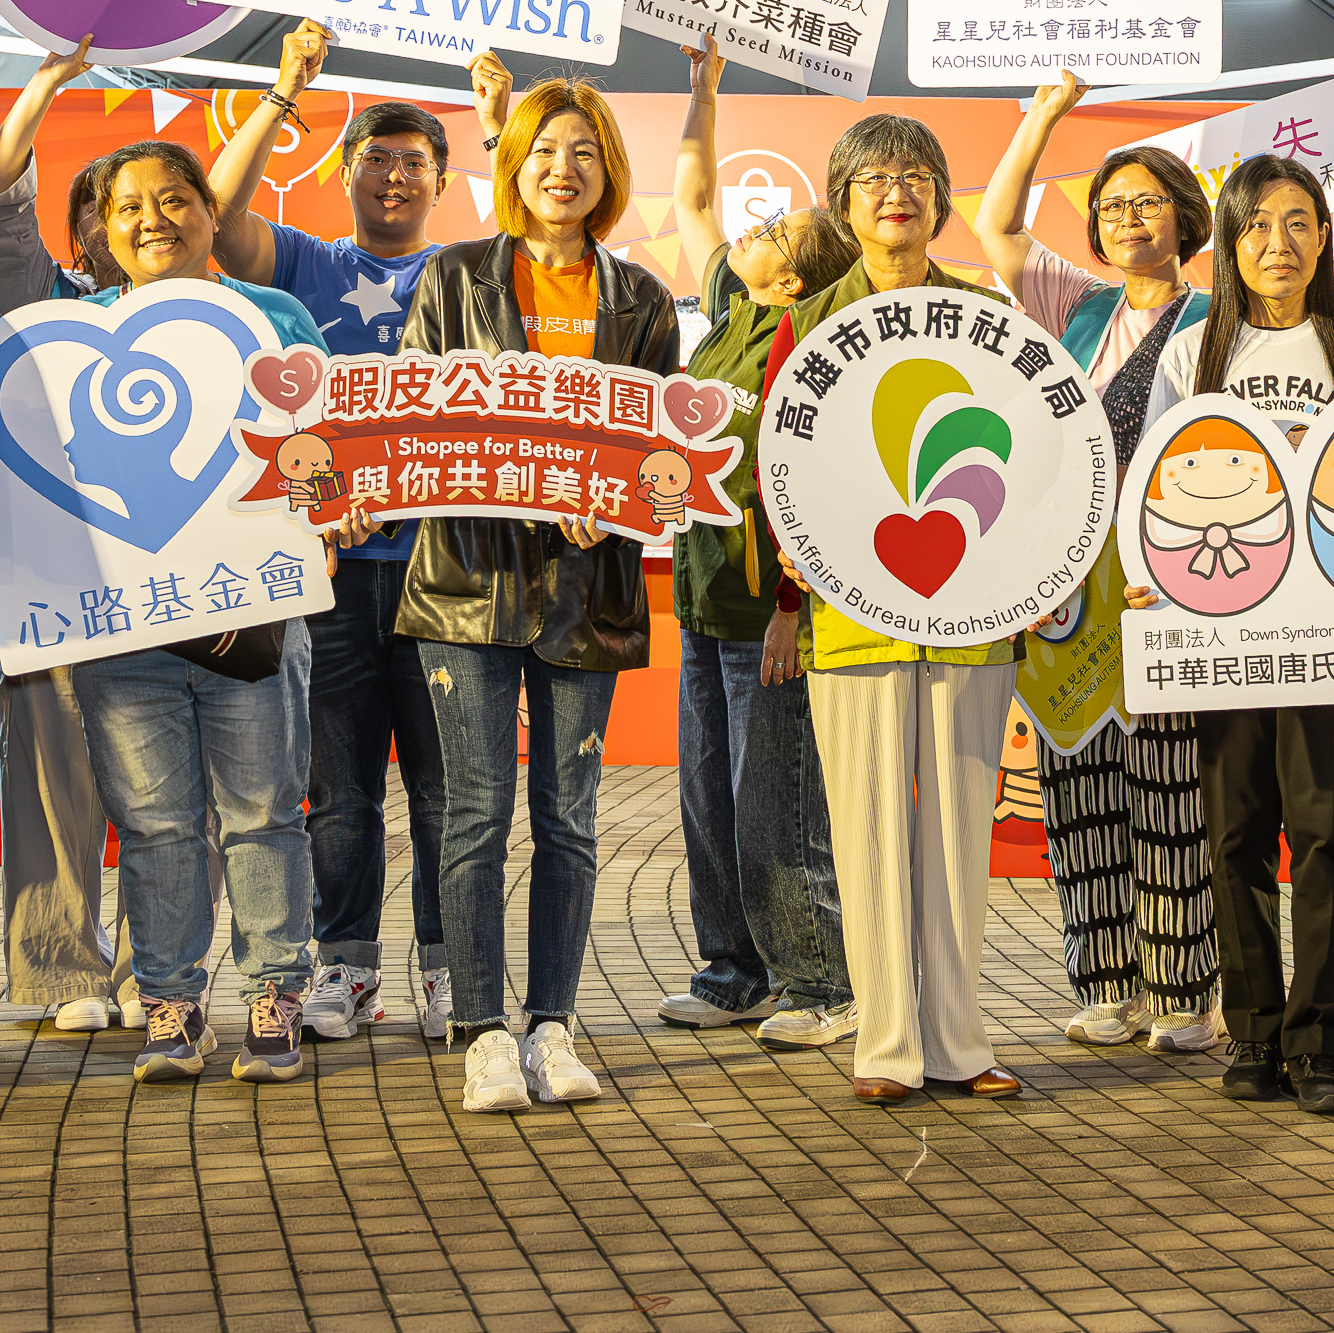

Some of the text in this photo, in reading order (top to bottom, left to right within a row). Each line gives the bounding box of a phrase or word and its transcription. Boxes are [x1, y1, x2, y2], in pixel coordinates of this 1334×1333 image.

[395, 27, 475, 52] TAIWAN
[932, 16, 1202, 42] 星星兒社會福利基金會
[725, 27, 770, 54] Seed
[777, 44, 854, 83] Mission
[932, 51, 1201, 69] KAOHSIUNG AUTISM FOUNDATION
[279, 368, 301, 398] S
[774, 298, 1088, 442] 高雄市政府社會局
[329, 361, 655, 433] 蝦皮公益樂園
[684, 397, 706, 425] S
[397, 437, 585, 462] Shopee for Better
[348, 460, 630, 519] 與你共創美好
[770, 435, 1107, 636] Social Affairs Bureau Kaohsiung City Government
[19, 549, 306, 649] 心路基金會
[1070, 622, 1106, 660] 財團法人
[1144, 627, 1225, 651] 財團法人
[1239, 627, 1279, 643] Down
[1047, 620, 1122, 713] 星星兒社會福利
[1058, 657, 1121, 725] KAOHSIUNG AUTISM
